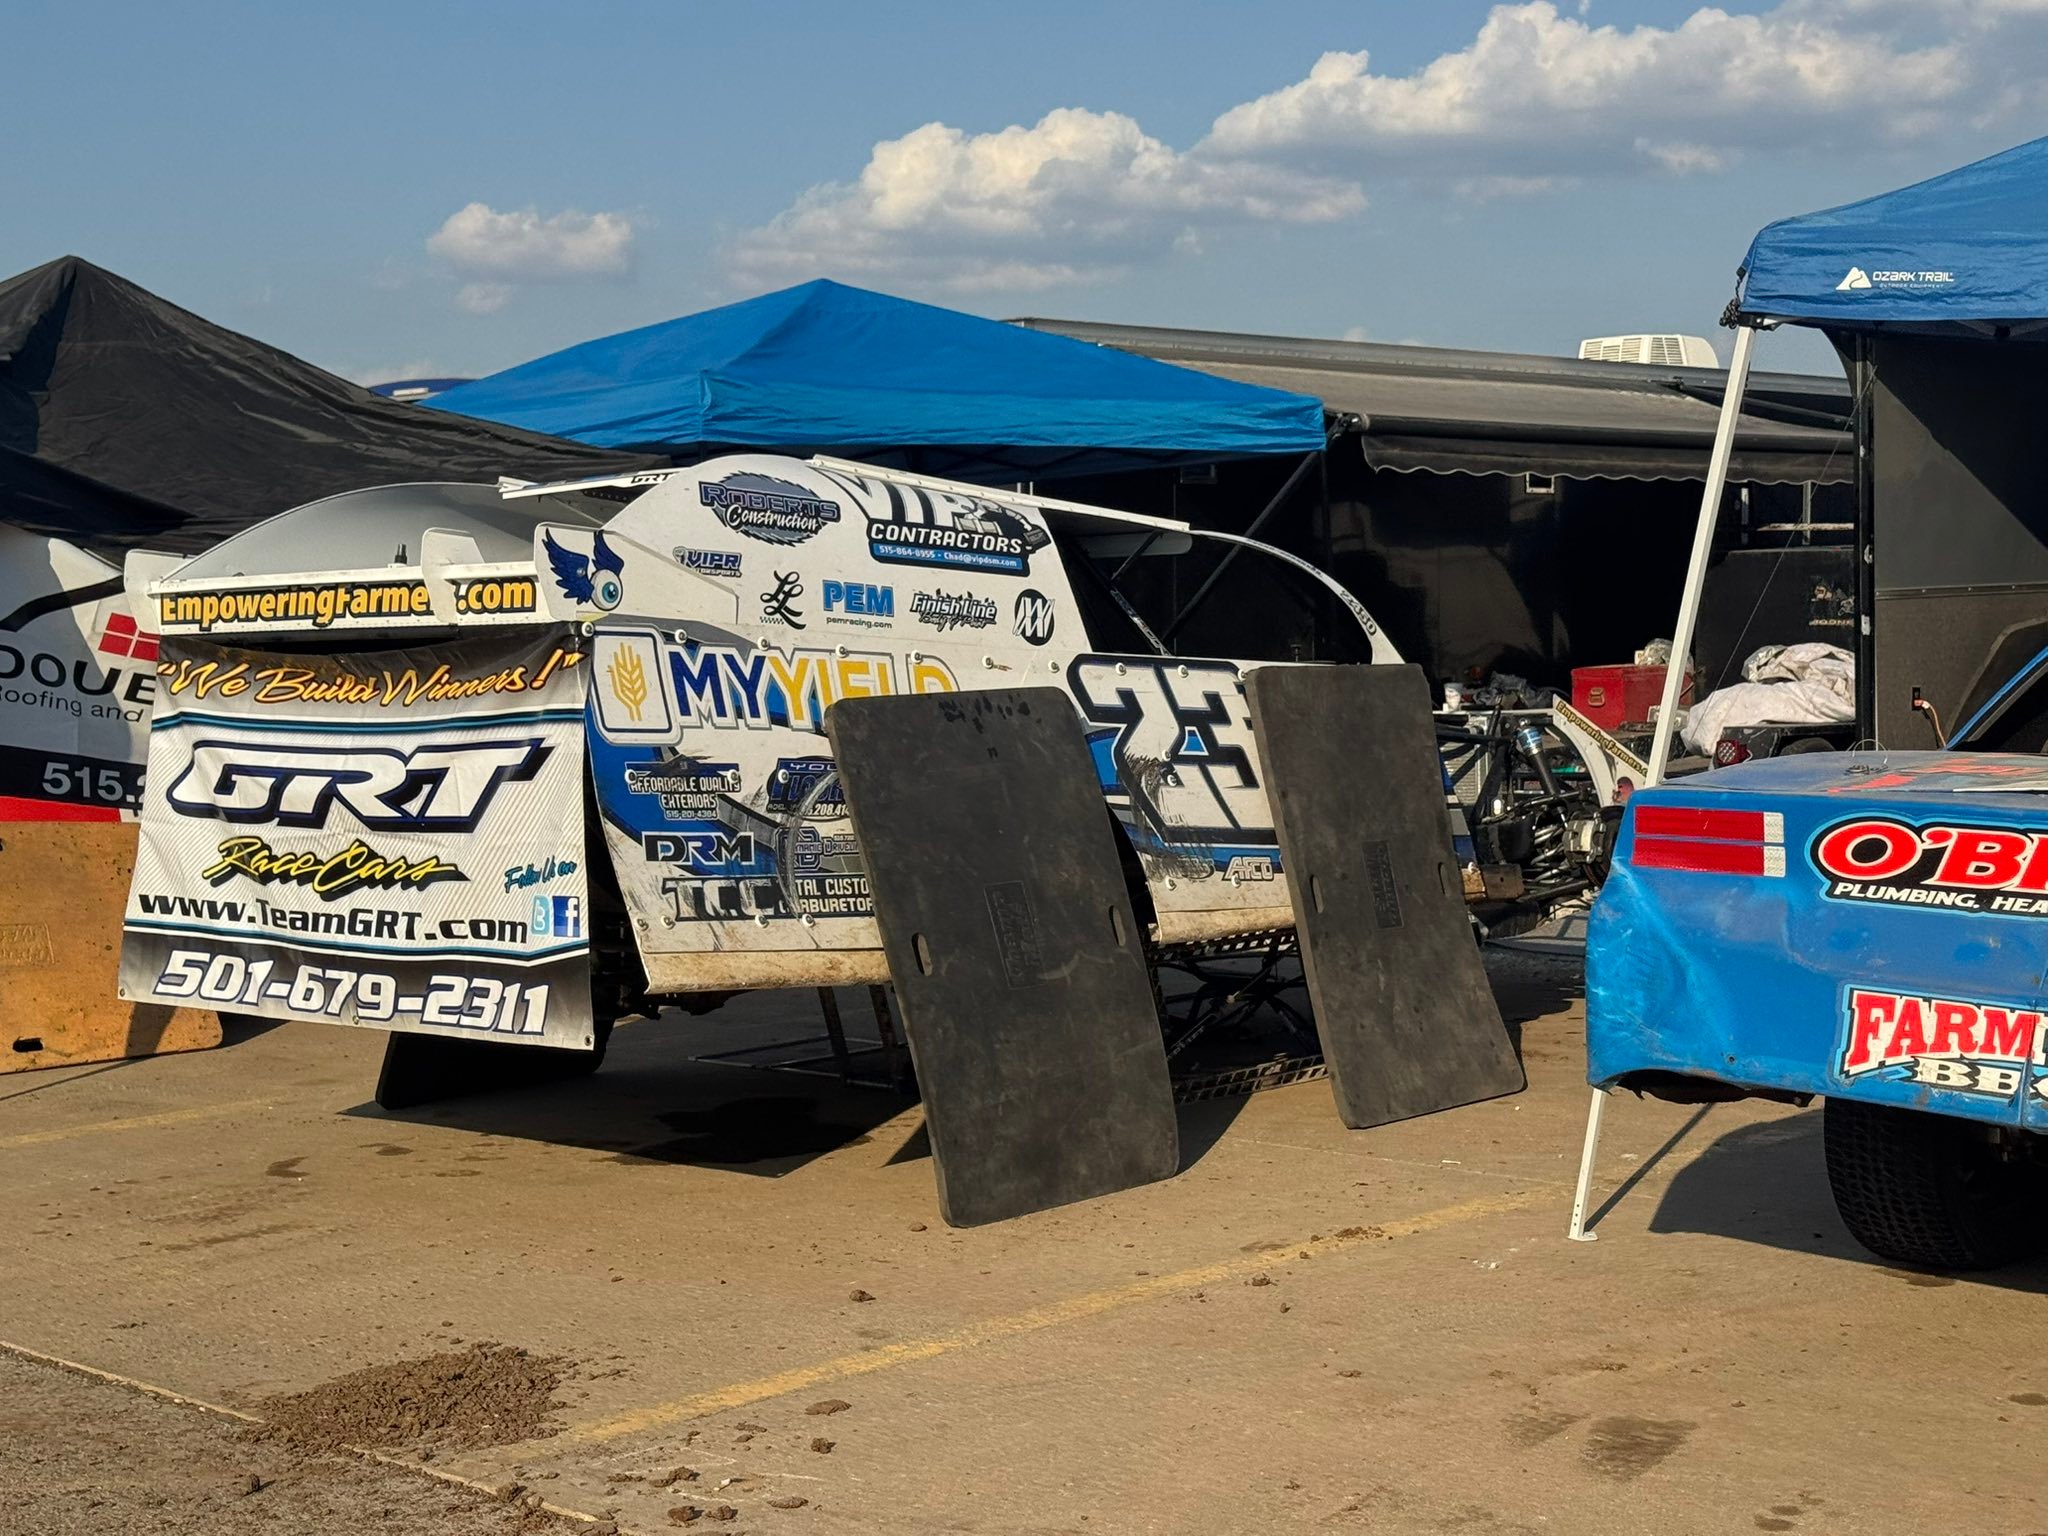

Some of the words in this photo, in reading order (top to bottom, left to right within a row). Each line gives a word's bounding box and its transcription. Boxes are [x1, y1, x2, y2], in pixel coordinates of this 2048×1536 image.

[1872, 271, 1916, 282] OZARK
[1918, 271, 1955, 282] TRAIL
[700, 483, 840, 520] ROBERTS
[726, 503, 818, 531] Construction
[870, 522, 1023, 554] CONTRACTORS
[686, 549, 741, 569] VIPR
[161, 580, 535, 630] EmpoweringFarme.com
[822, 579, 895, 618] PEM
[909, 592, 962, 617] Finish
[961, 598, 997, 621] Line
[826, 616, 893, 629] pemracing.com
[254, 666, 379, 704] Build
[0, 684, 82, 717] oofing
[91, 702, 145, 723] and
[166, 739, 553, 832] GRT
[660, 793, 718, 809] EXTERIORS
[643, 832, 755, 864] DRM
[201, 836, 323, 884] Race
[312, 838, 468, 897] Cars
[1222, 856, 1274, 881] AFCO
[138, 893, 528, 945] www.TeamGRT.com
[153, 949, 551, 1037] 501-679-2311
